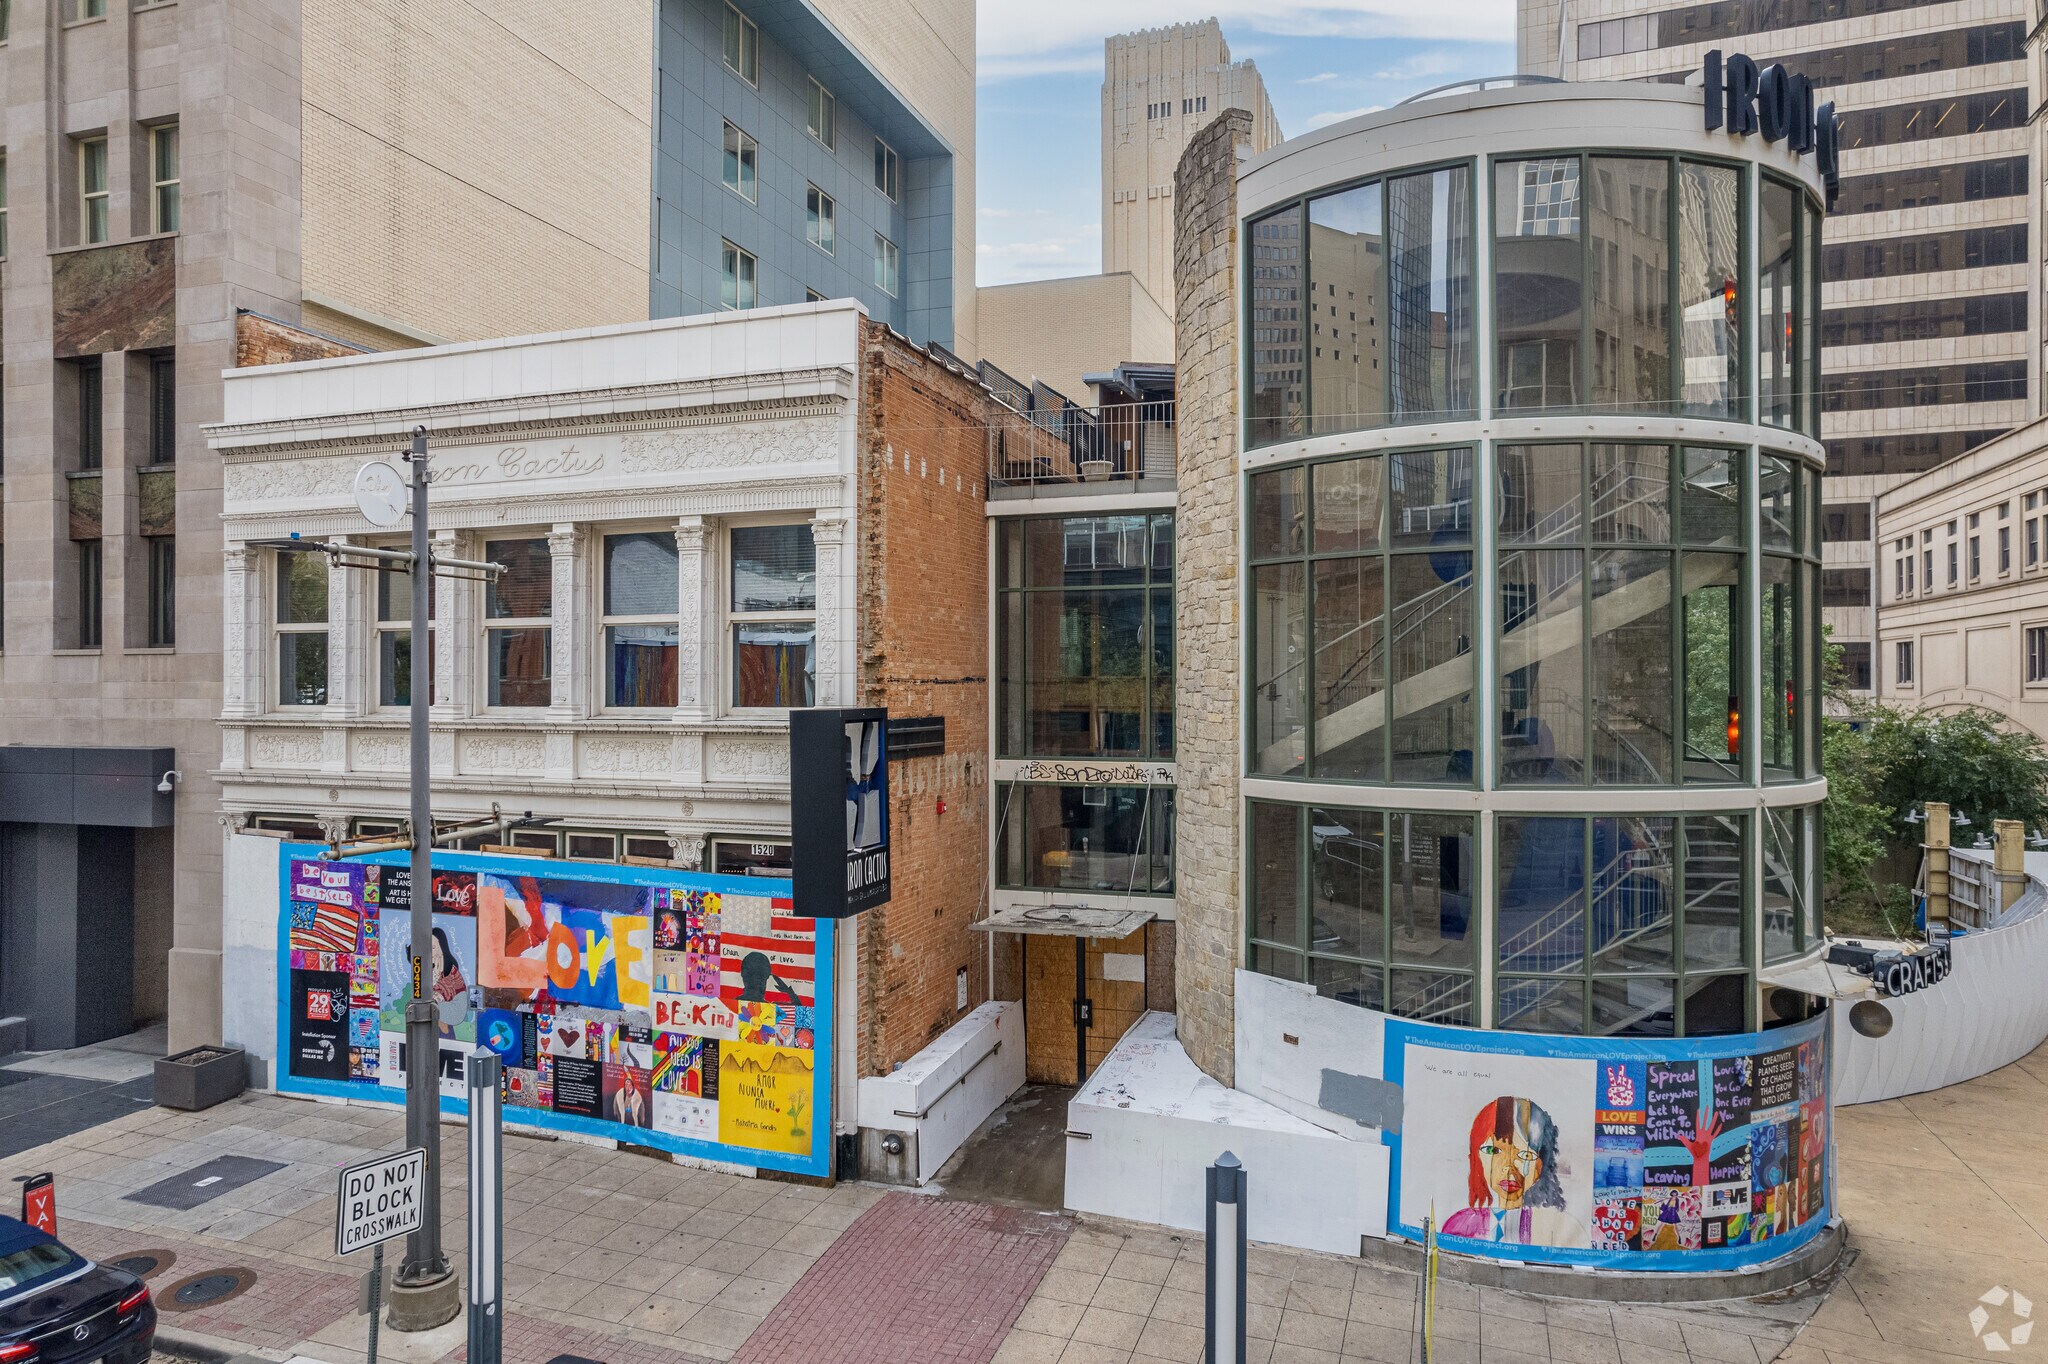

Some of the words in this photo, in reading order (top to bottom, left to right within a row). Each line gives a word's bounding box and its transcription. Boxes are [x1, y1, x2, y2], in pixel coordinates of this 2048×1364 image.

[498, 445, 605, 477] Cactus
[752, 844, 774, 856] 1520
[396, 871, 411, 879] LOVE
[847, 858, 863, 892] IRON
[864, 851, 887, 885] CACTUS
[387, 878, 398, 886] THE
[637, 878, 712, 893] TheAmericanLOVEproject.org
[309, 993, 329, 1009] 29
[1410, 1036, 1525, 1056] TheAmericanLOVEproject.org
[1554, 1050, 1667, 1061] TheAmericanLOVEproject.org
[1762, 1051, 1792, 1066] CREATIVITY
[1424, 1064, 1437, 1073] We
[1458, 1069, 1468, 1077] all
[1758, 1064, 1779, 1077] PLANTS
[1779, 1060, 1795, 1072] SEEDS
[757, 1074, 777, 1089] AMOR
[1649, 1065, 1696, 1090] Spread
[1760, 1076, 1769, 1086] OF
[1769, 1070, 1793, 1084] CHANGE
[738, 1082, 765, 1098] NUNCA
[1648, 1088, 1698, 1103] Everywhere
[1714, 1082, 1728, 1094] You
[1728, 1080, 1741, 1092] Go
[1760, 1085, 1775, 1096] THAT
[1775, 1080, 1793, 1093] GROW
[754, 1097, 776, 1111] MUERE
[1648, 1104, 1668, 1116] Let
[1671, 1105, 1685, 1115] No
[1715, 1098, 1729, 1108] One
[1731, 1095, 1752, 1108] Ever
[1761, 1095, 1777, 1106] INTO
[1602, 1111, 1638, 1123] LOVE
[1646, 1117, 1676, 1129] Come
[1676, 1115, 1692, 1128] To
[1719, 1110, 1735, 1123] You
[1602, 1124, 1637, 1136] WINS
[1645, 1126, 1696, 1142] Without
[350, 1173, 375, 1198] DO
[384, 1160, 418, 1188] NOT
[1644, 1168, 1691, 1187] Leaving
[352, 1185, 413, 1222] BLOCK
[1594, 1199, 1637, 1208] LOVE
[1643, 1205, 1661, 1217] YOU
[346, 1207, 416, 1245] CROSSWALK
[1591, 1218, 1633, 1229] WHAT
[1606, 1232, 1625, 1240] WE
[1548, 1246, 1661, 1260] TheAmericanLOVEproject.org
[1591, 1241, 1628, 1251] NEED
